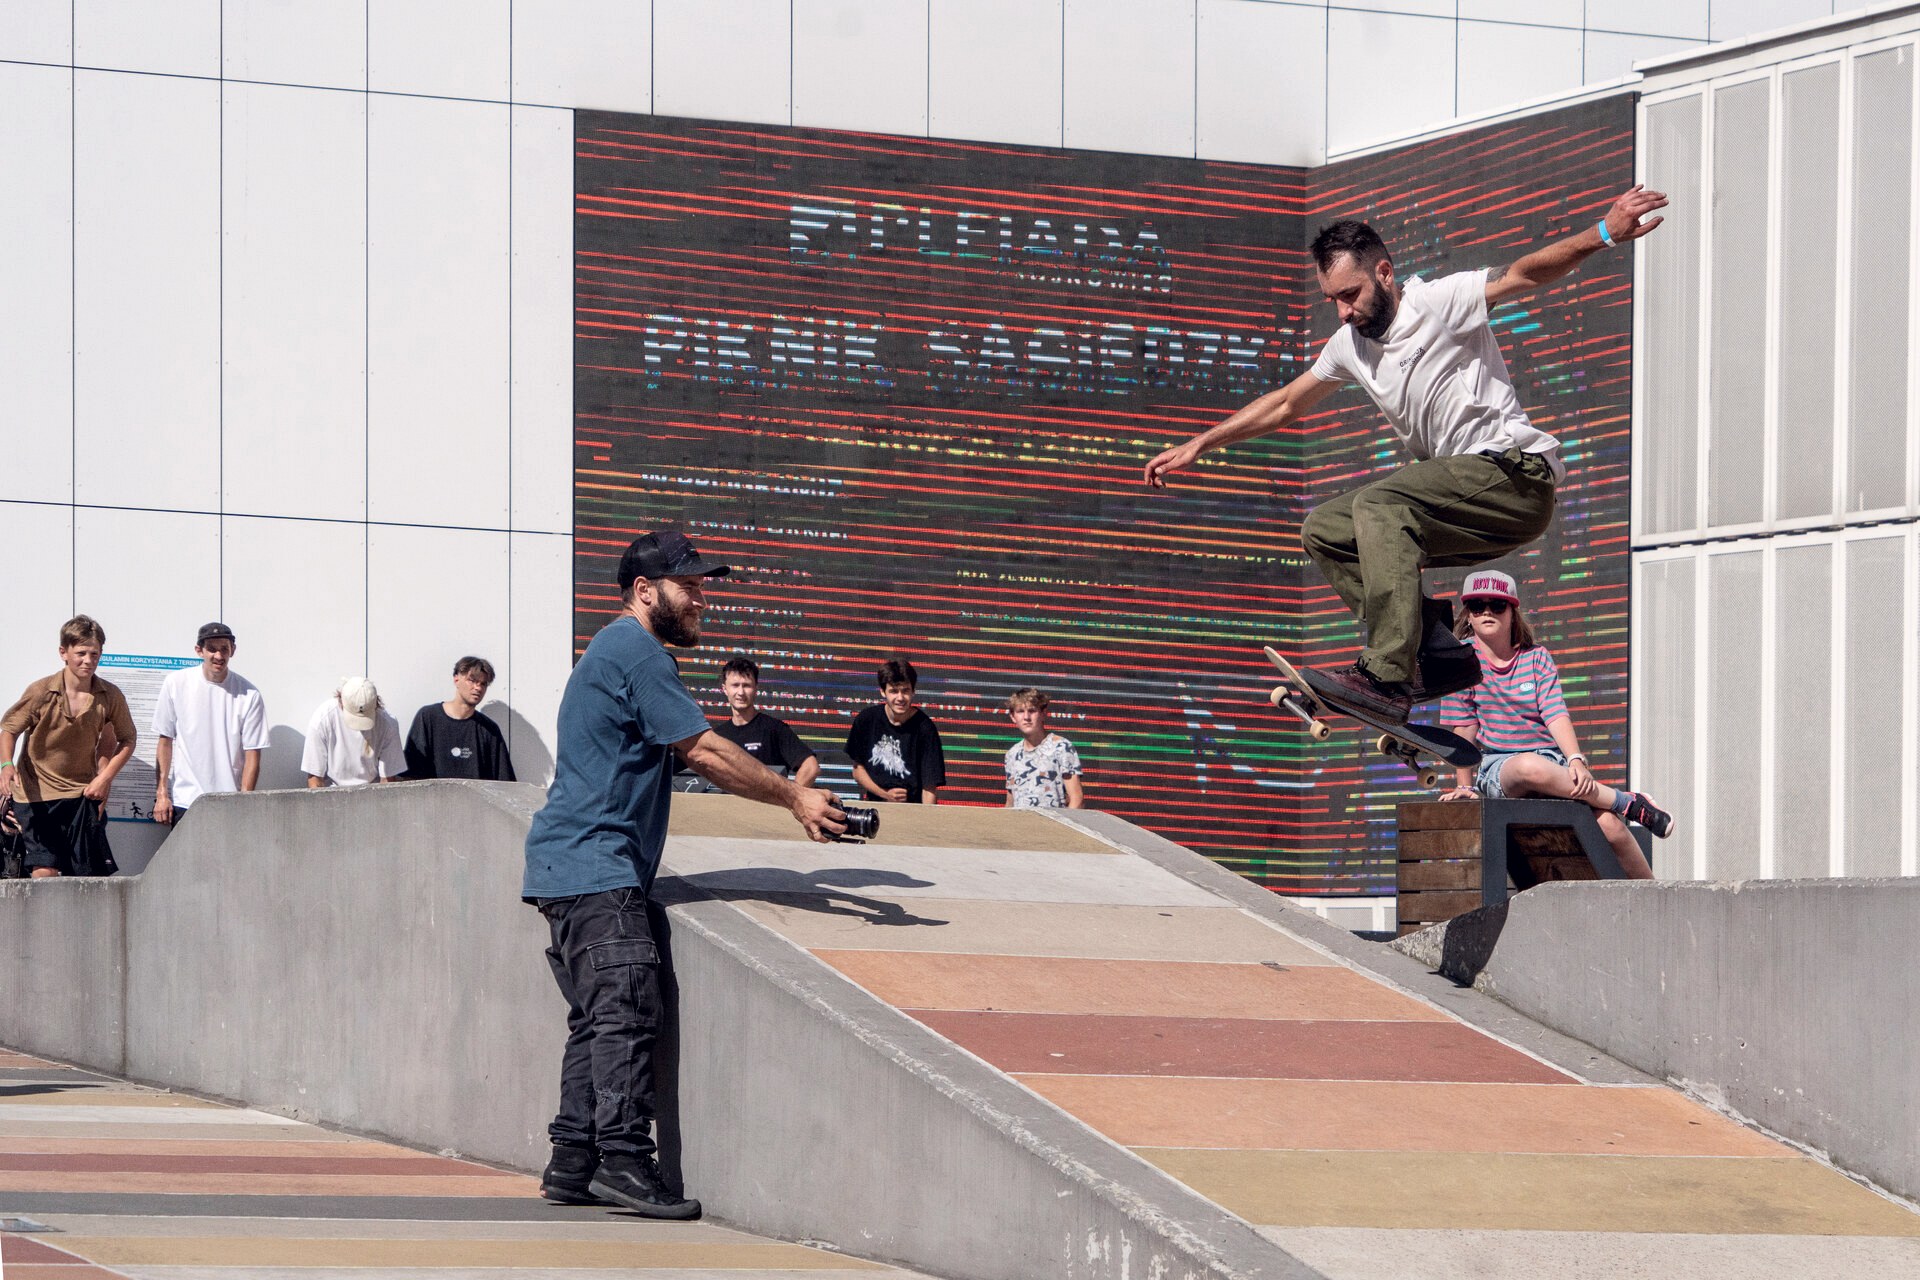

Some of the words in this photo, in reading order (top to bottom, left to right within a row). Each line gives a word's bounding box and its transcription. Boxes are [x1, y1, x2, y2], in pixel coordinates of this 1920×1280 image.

[1473, 577, 1490, 591] NEW
[1491, 577, 1509, 594] YORK
[131, 657, 172, 665] KORZYSTANIA
